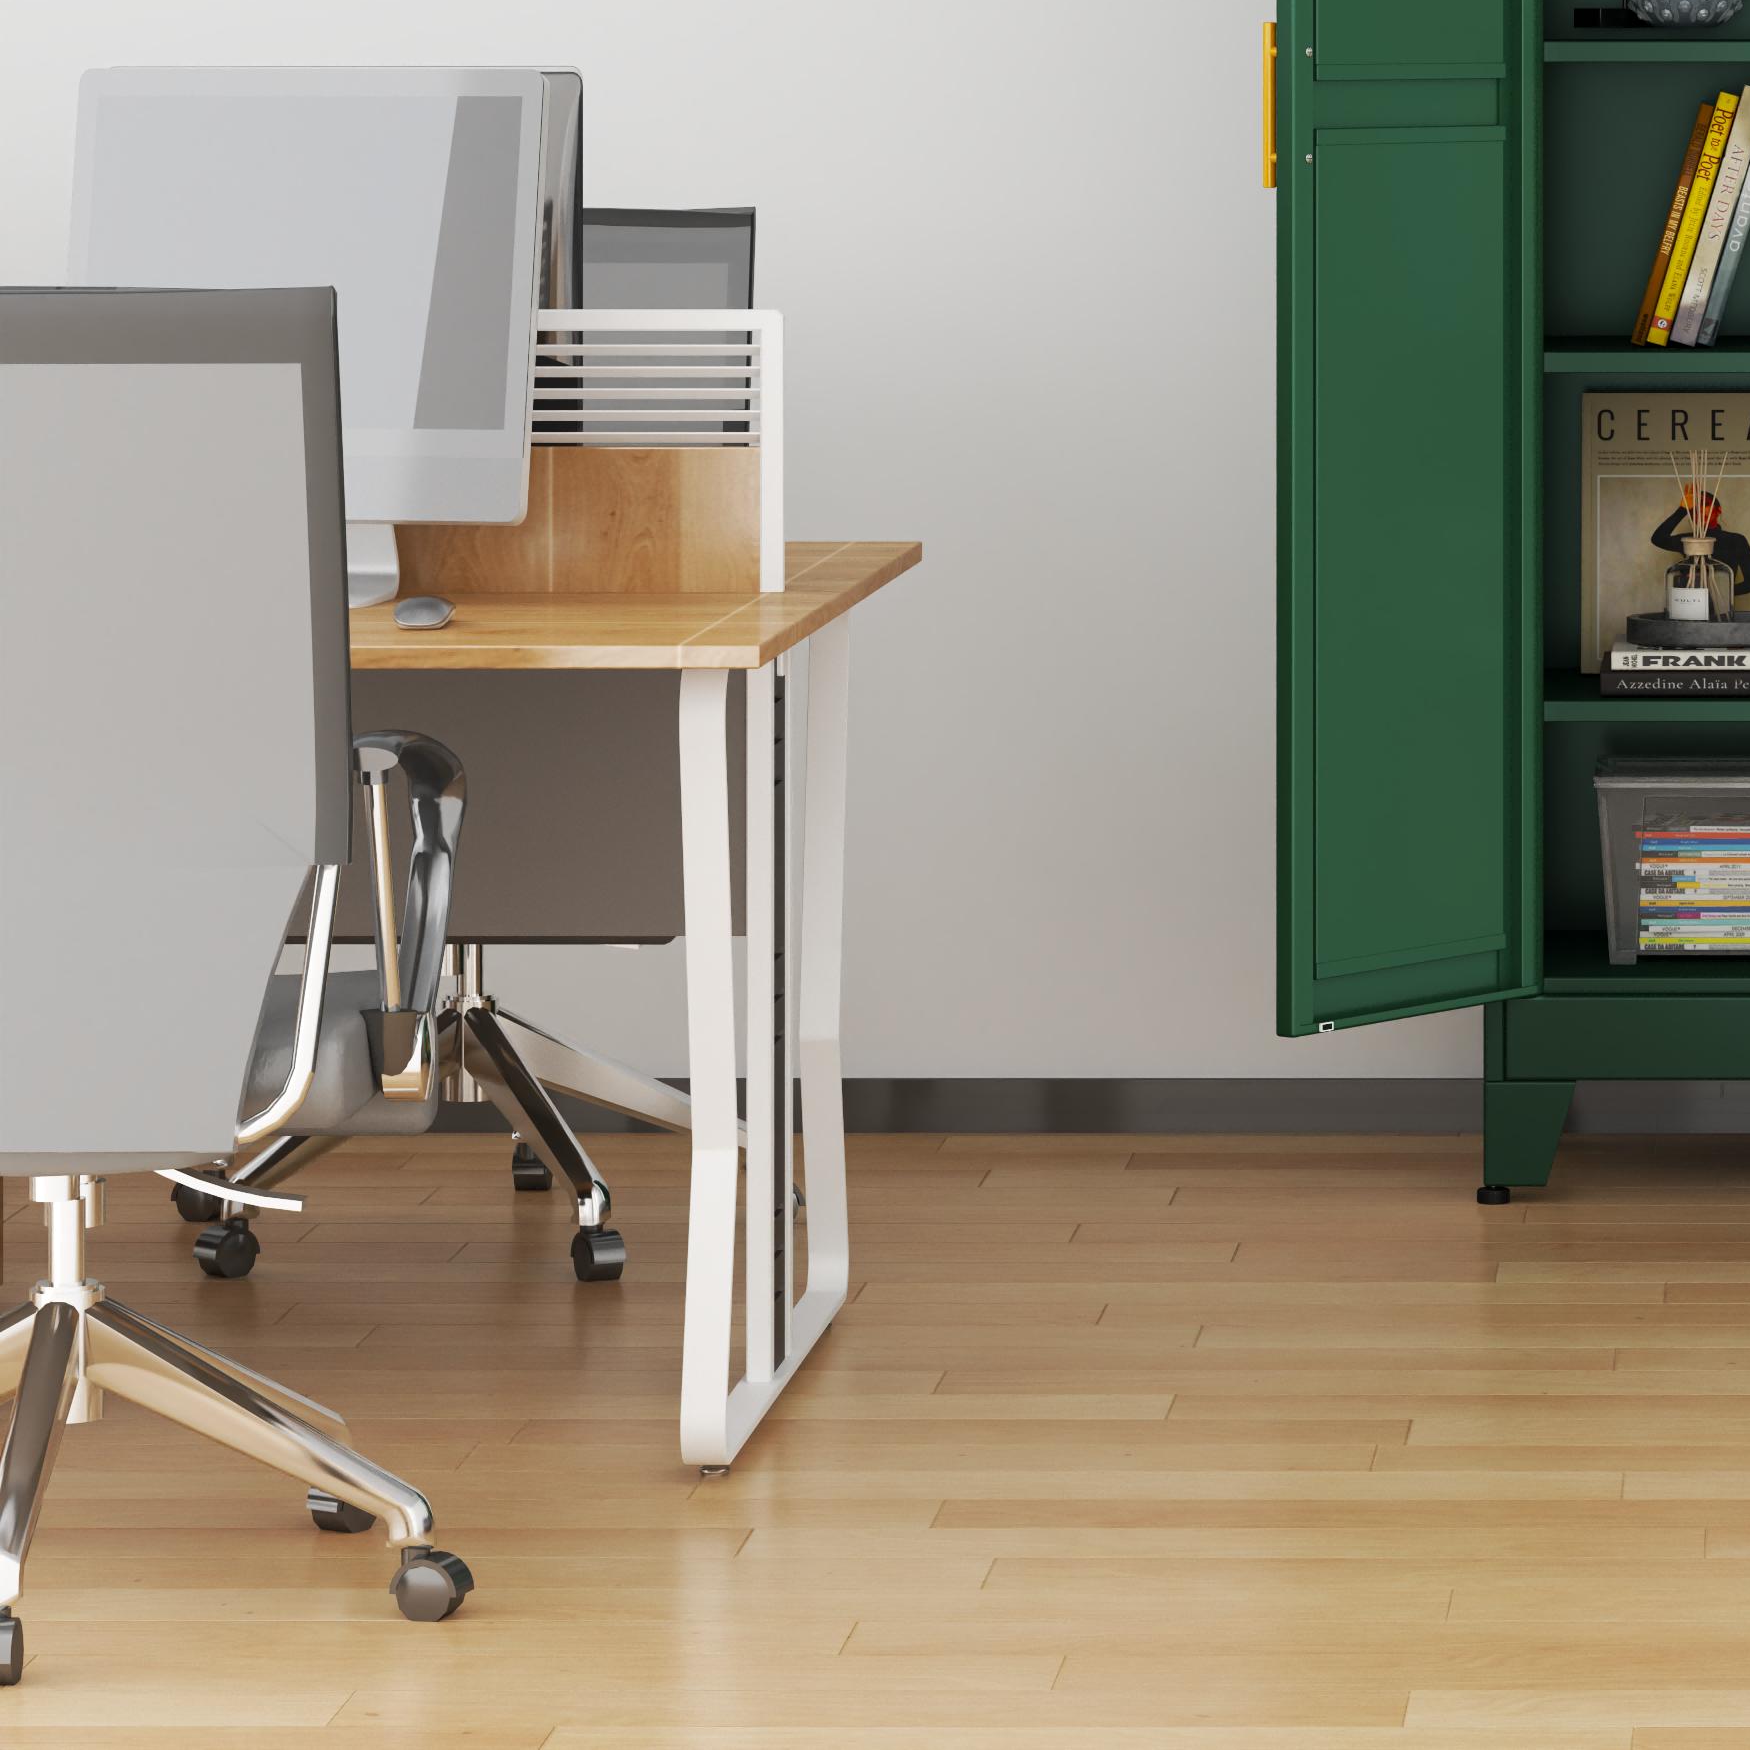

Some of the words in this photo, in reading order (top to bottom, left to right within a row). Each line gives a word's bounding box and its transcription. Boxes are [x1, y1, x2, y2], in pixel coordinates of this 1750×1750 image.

[1709, 107, 1734, 135] Poet
[1696, 153, 1721, 182] Poet
[1720, 144, 1745, 195] AFTER
[1672, 185, 1689, 210] BEASTS
[1667, 220, 1680, 230] MY
[1708, 200, 1730, 242] DAYS
[1659, 230, 1677, 256] BELFRY
[1642, 655, 1747, 666] FRANK
[1616, 678, 1684, 690] Azzedine
[1688, 678, 1727, 690] Alaïa
